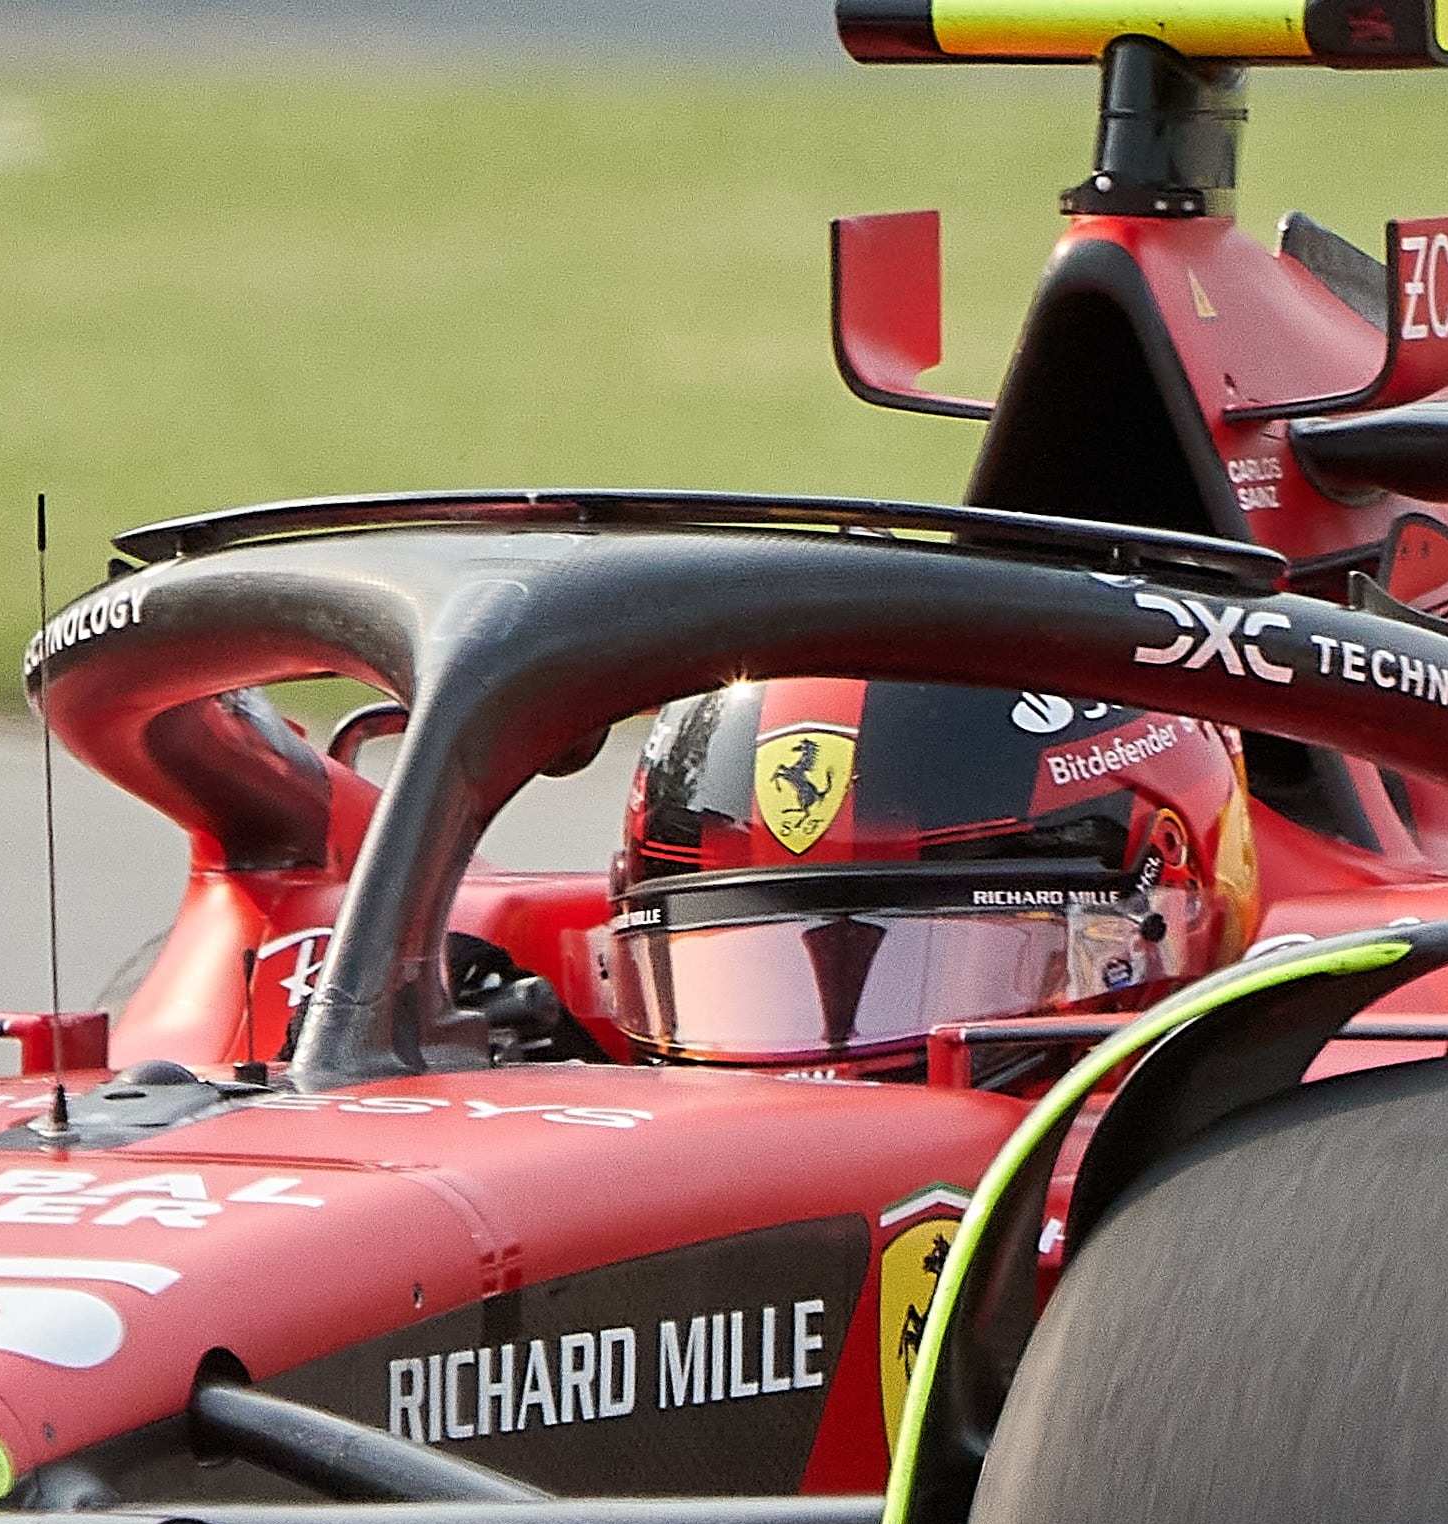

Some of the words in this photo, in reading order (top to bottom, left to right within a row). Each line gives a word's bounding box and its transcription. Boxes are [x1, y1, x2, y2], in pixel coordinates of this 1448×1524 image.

[1227, 457, 1283, 484] CARLOS
[1237, 486, 1281, 511] SAINZ
[1133, 592, 1295, 684] DXC
[1048, 723, 1179, 785] Bitdefender
[973, 890, 1063, 905] RICHARD
[1067, 890, 1120, 904] MILLE
[389, 1326, 636, 1443] RICHARD
[657, 1300, 825, 1410] MILLE
